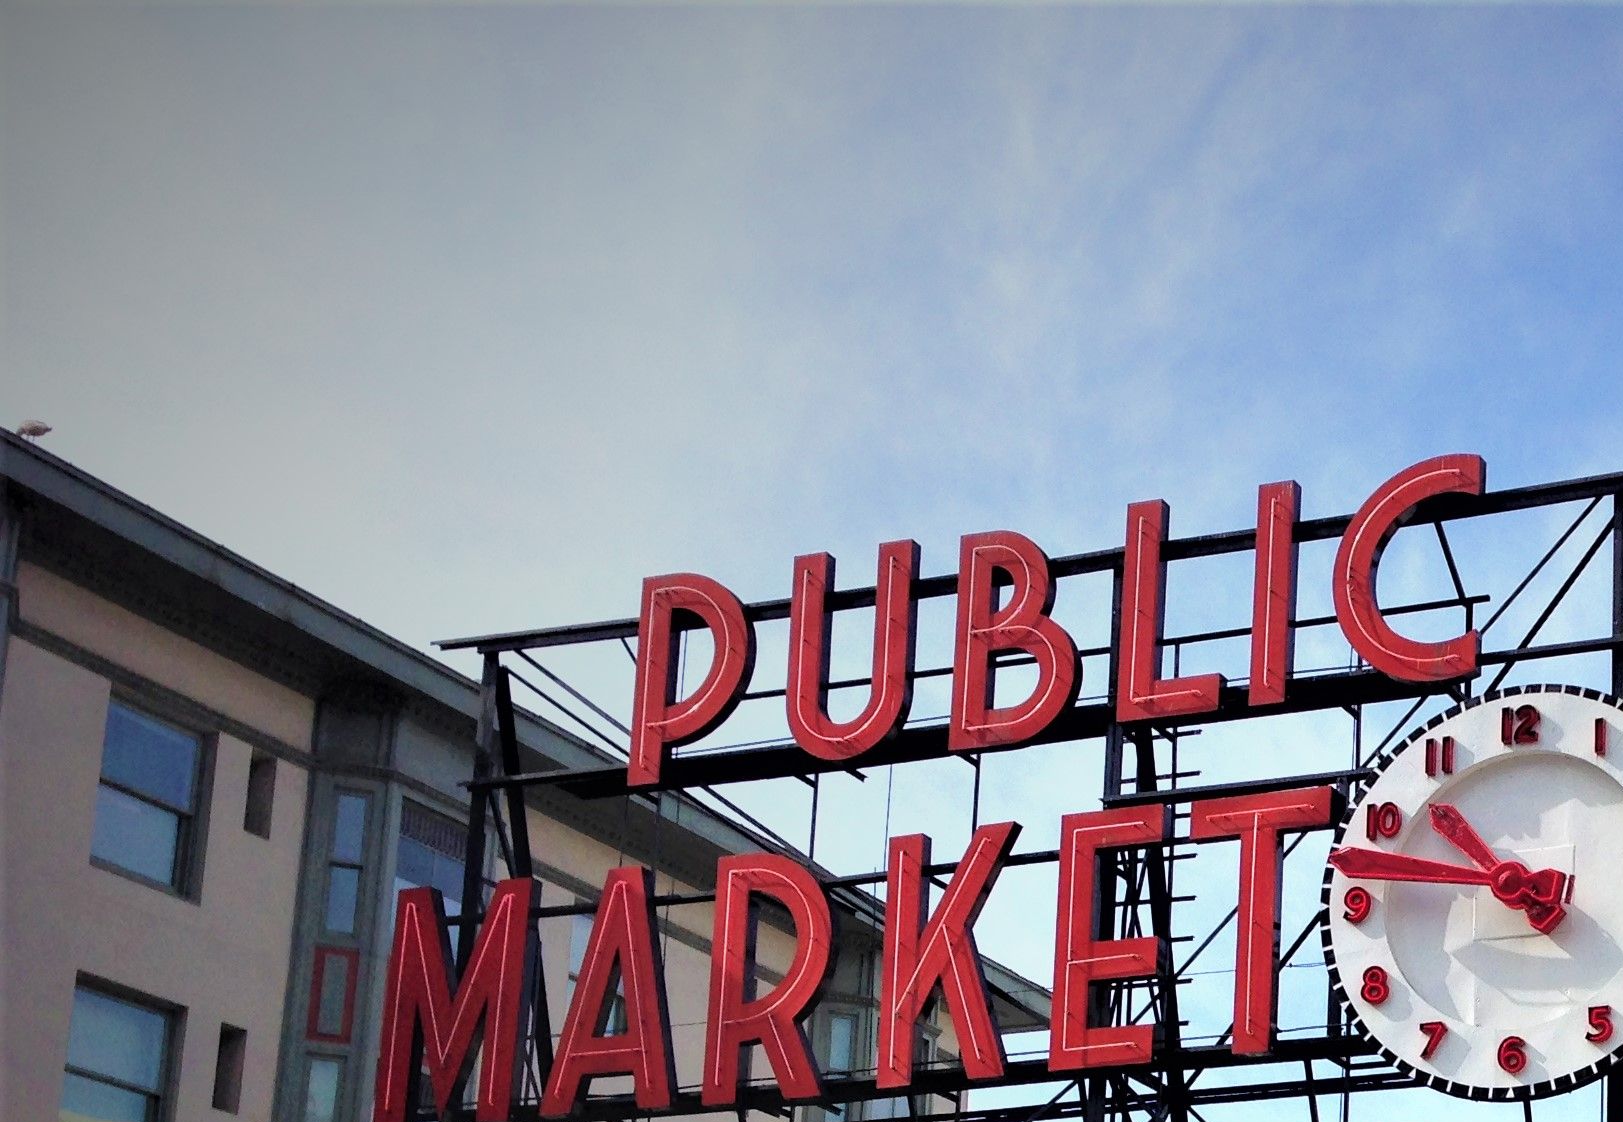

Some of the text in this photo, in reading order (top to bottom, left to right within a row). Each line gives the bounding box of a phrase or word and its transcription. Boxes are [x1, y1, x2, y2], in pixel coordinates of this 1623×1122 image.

[627, 454, 1486, 786] PUBLIC
[1501, 705, 1541, 745] 12
[1595, 718, 1607, 757] 1
[1425, 736, 1455, 777] 11
[1367, 801, 1402, 841] 10
[1343, 886, 1372, 923] 9
[1361, 966, 1390, 1004] 8
[1419, 1021, 1448, 1060] 7
[1585, 1005, 1614, 1044] 5
[1497, 1036, 1527, 1074] 6
